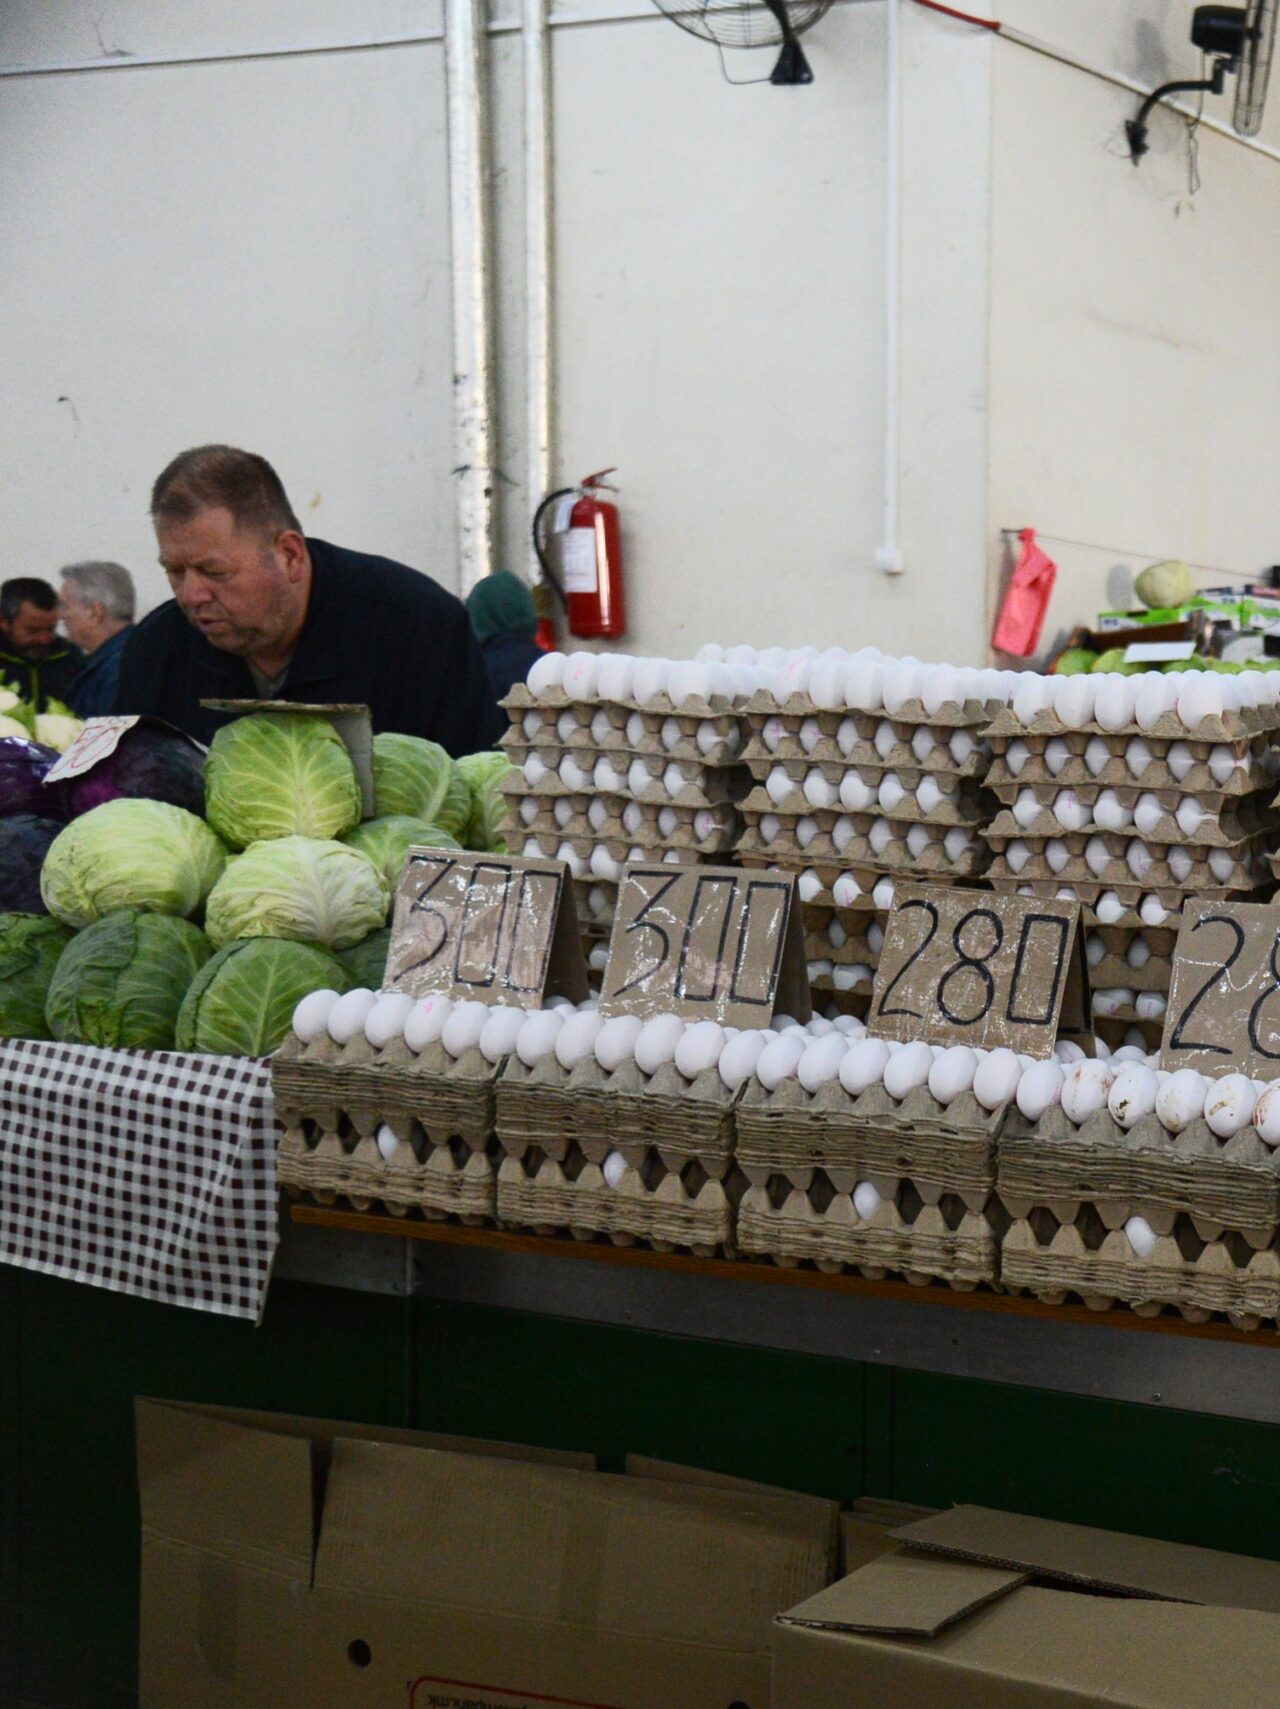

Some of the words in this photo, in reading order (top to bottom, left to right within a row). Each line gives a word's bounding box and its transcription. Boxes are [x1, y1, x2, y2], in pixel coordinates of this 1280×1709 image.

[393, 854, 562, 993] 300
[612, 870, 791, 1006] 300
[877, 899, 1069, 1026] 280
